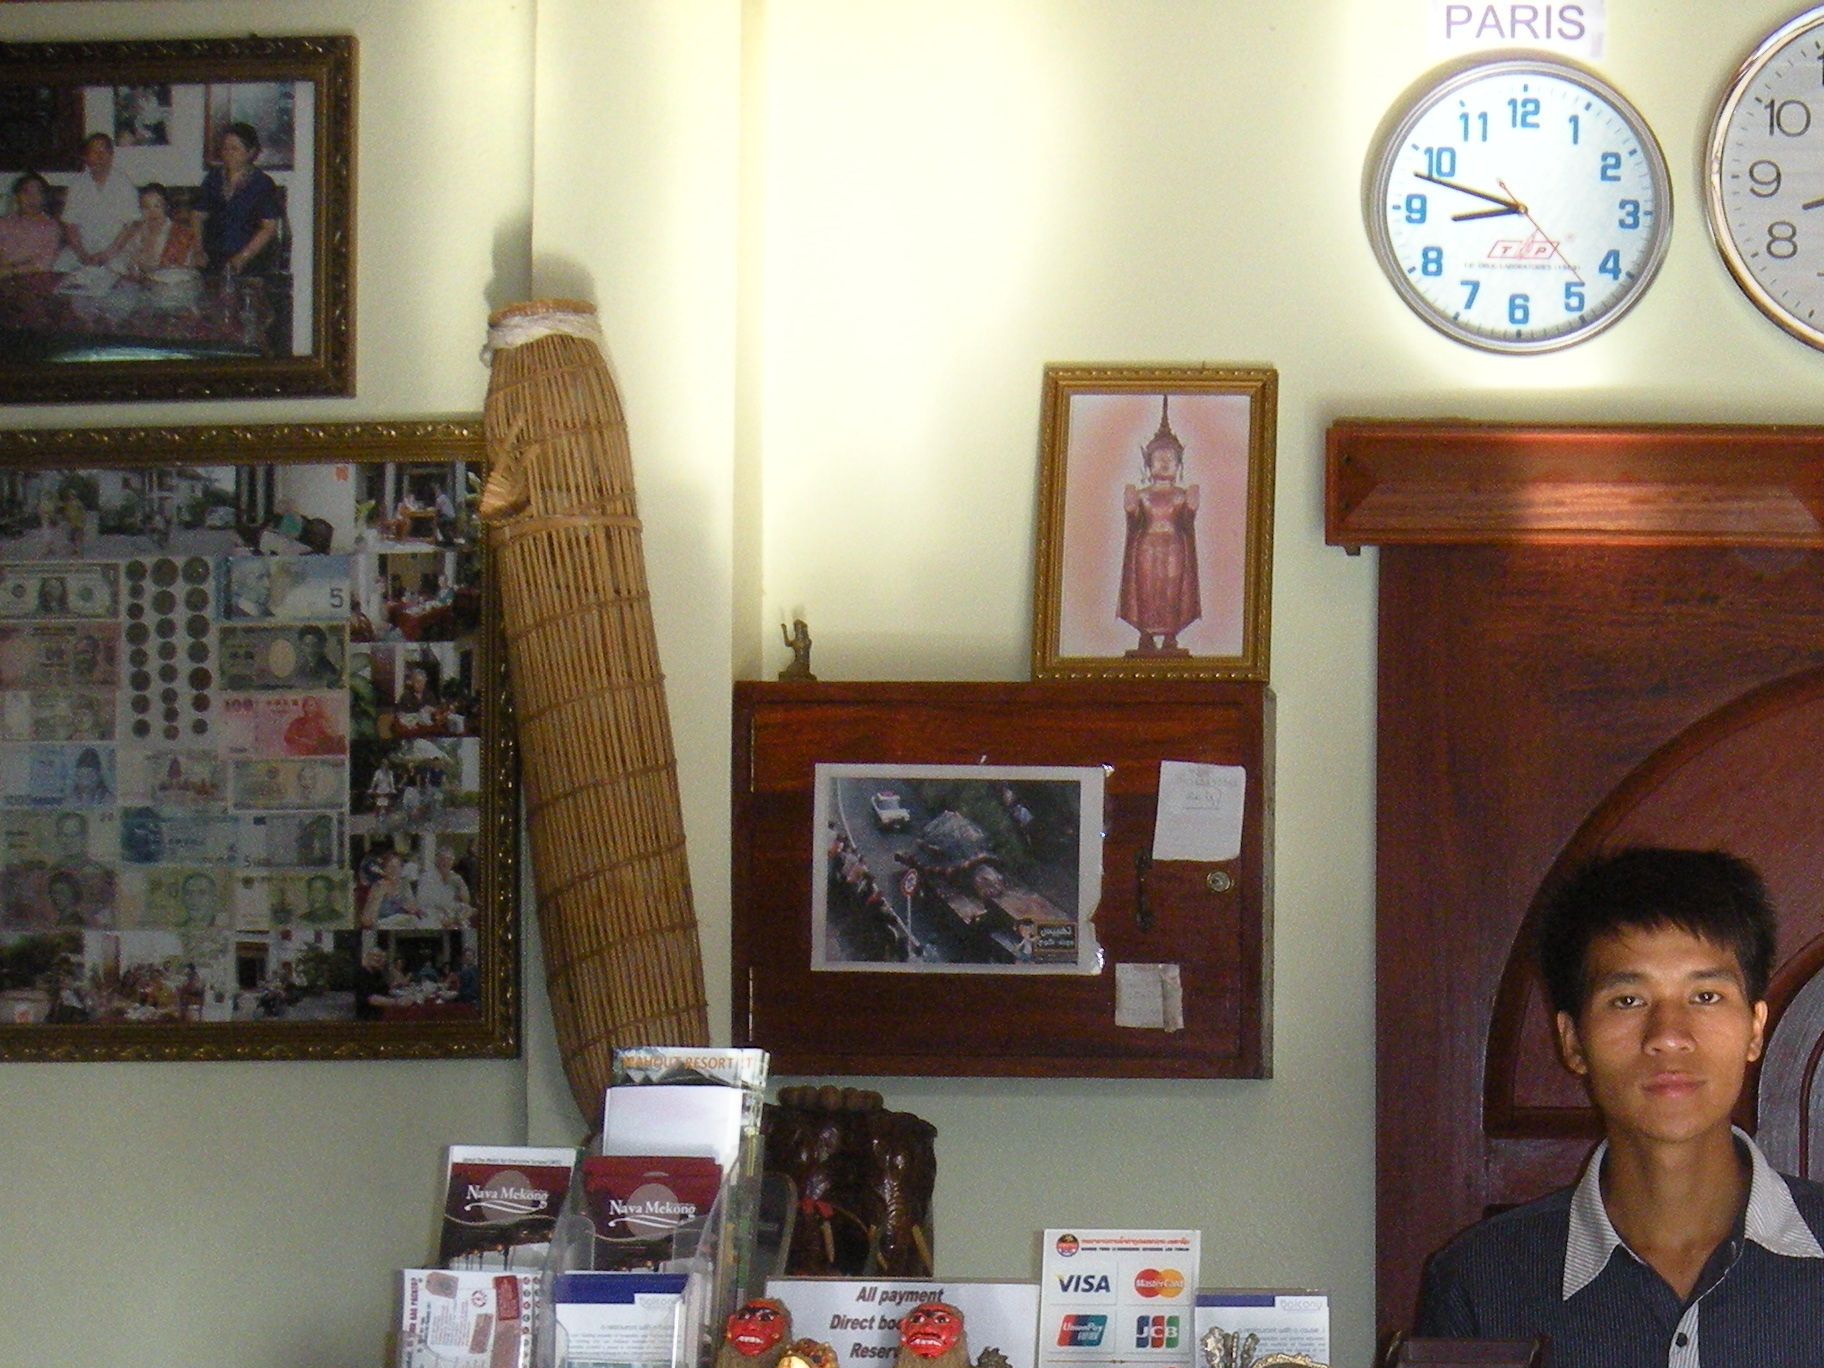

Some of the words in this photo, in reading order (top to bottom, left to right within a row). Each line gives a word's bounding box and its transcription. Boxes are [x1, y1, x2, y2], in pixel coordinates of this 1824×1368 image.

[1446, 5, 1586, 40] PARIS
[1460, 112, 1488, 142] 11
[1508, 98, 1540, 128] 12
[1765, 99, 1811, 137] 10
[1569, 115, 1579, 145] 1
[1424, 147, 1456, 178] 10
[1601, 152, 1621, 182] 2
[1749, 160, 1781, 198] 9
[1405, 194, 1427, 224] 9
[1619, 200, 1640, 230] 3
[1766, 221, 1797, 259] 8
[1422, 246, 1443, 276] 8
[1598, 249, 1621, 280] 4
[1460, 281, 1480, 309] 7
[1508, 294, 1529, 324] 6
[1565, 282, 1585, 312] 5
[330, 587, 344, 609] 5
[684, 1056, 734, 1069] RESORT
[466, 1184, 498, 1200] Nava
[500, 1185, 549, 1203] Mekong
[609, 1200, 642, 1214] Nava
[644, 1201, 696, 1216] Mekong
[857, 1287, 878, 1302] All
[879, 1289, 944, 1306] payment
[1058, 1275, 1111, 1293] VISA
[1136, 1279, 1184, 1288] MasterCard
[830, 1314, 875, 1330] Direct
